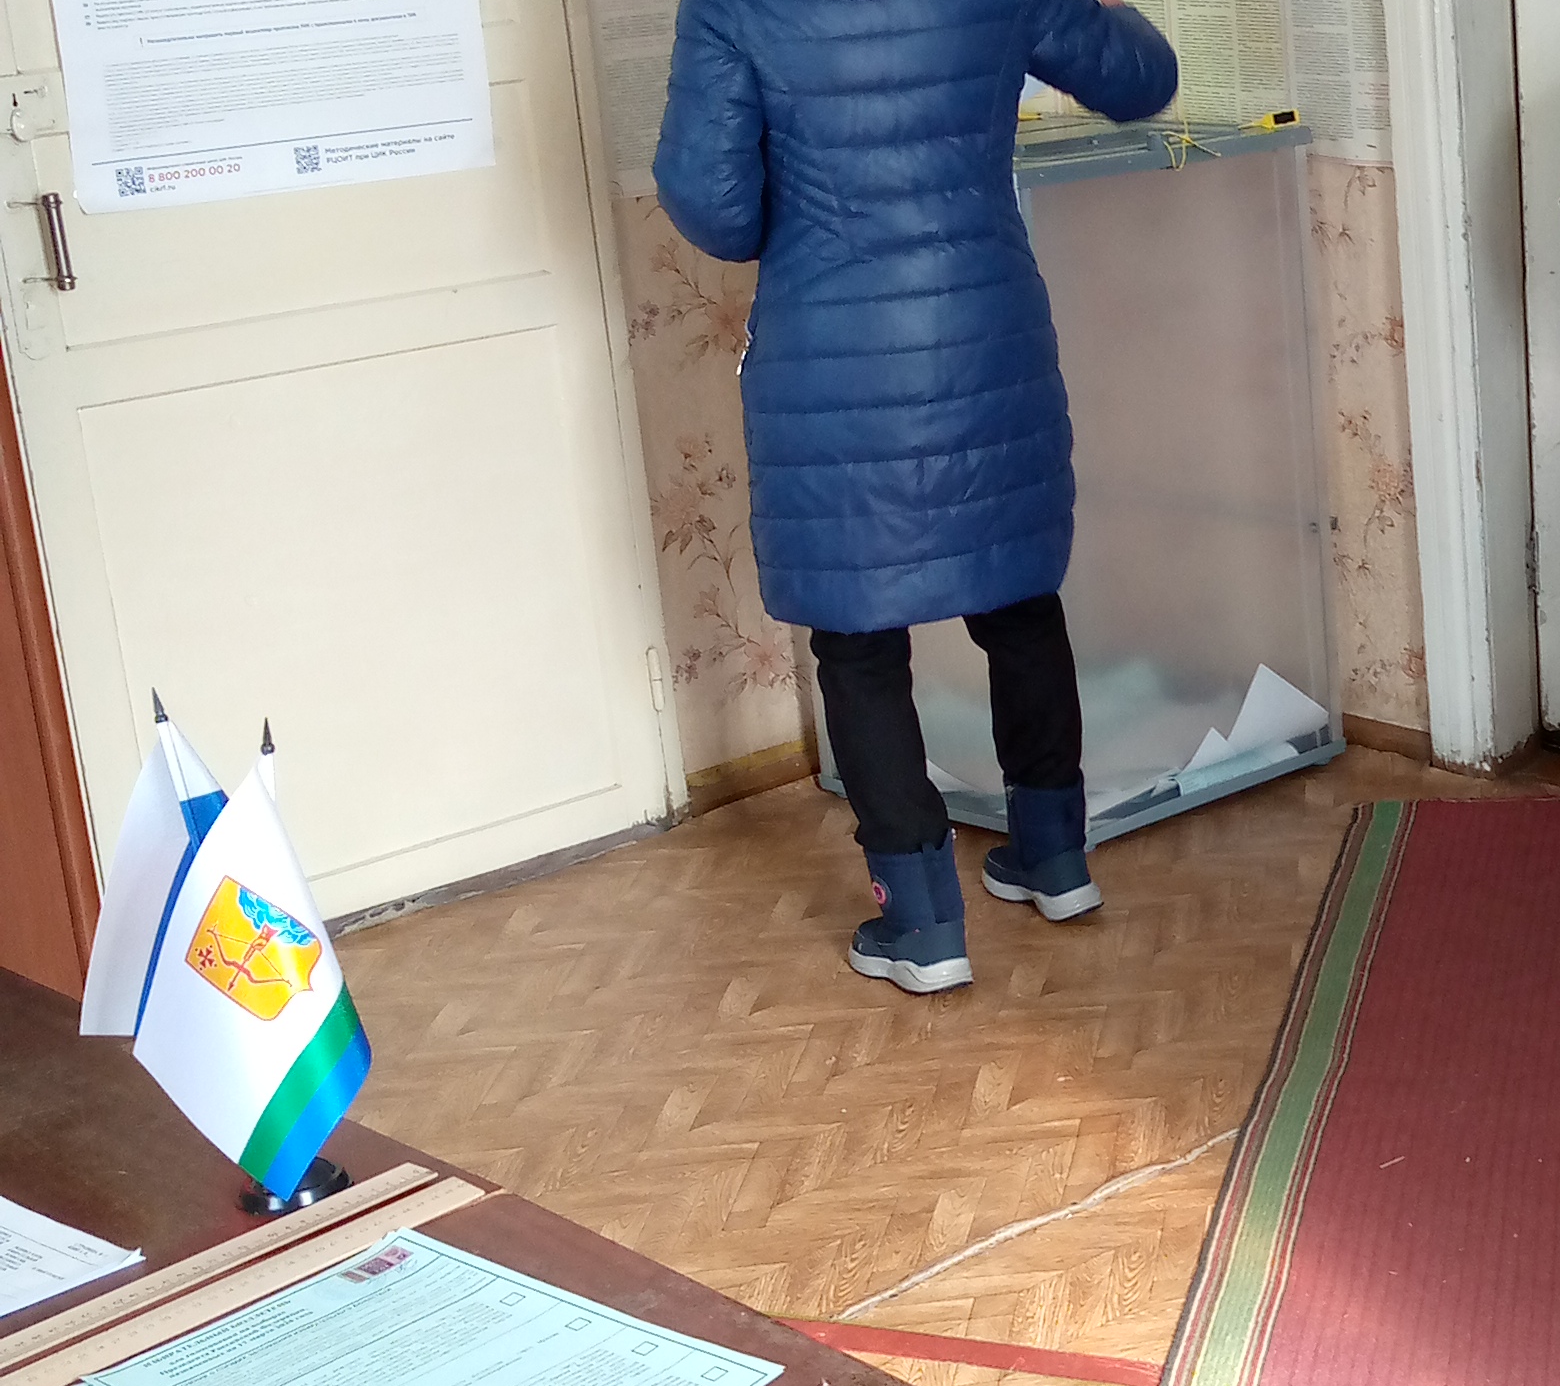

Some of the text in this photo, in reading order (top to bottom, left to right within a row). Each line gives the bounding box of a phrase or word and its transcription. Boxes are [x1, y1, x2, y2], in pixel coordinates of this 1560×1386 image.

[148, 174, 155, 183] 8
[158, 171, 181, 182] 800
[184, 168, 206, 179] 200
[209, 165, 224, 175] 00
[226, 163, 241, 173] 20
